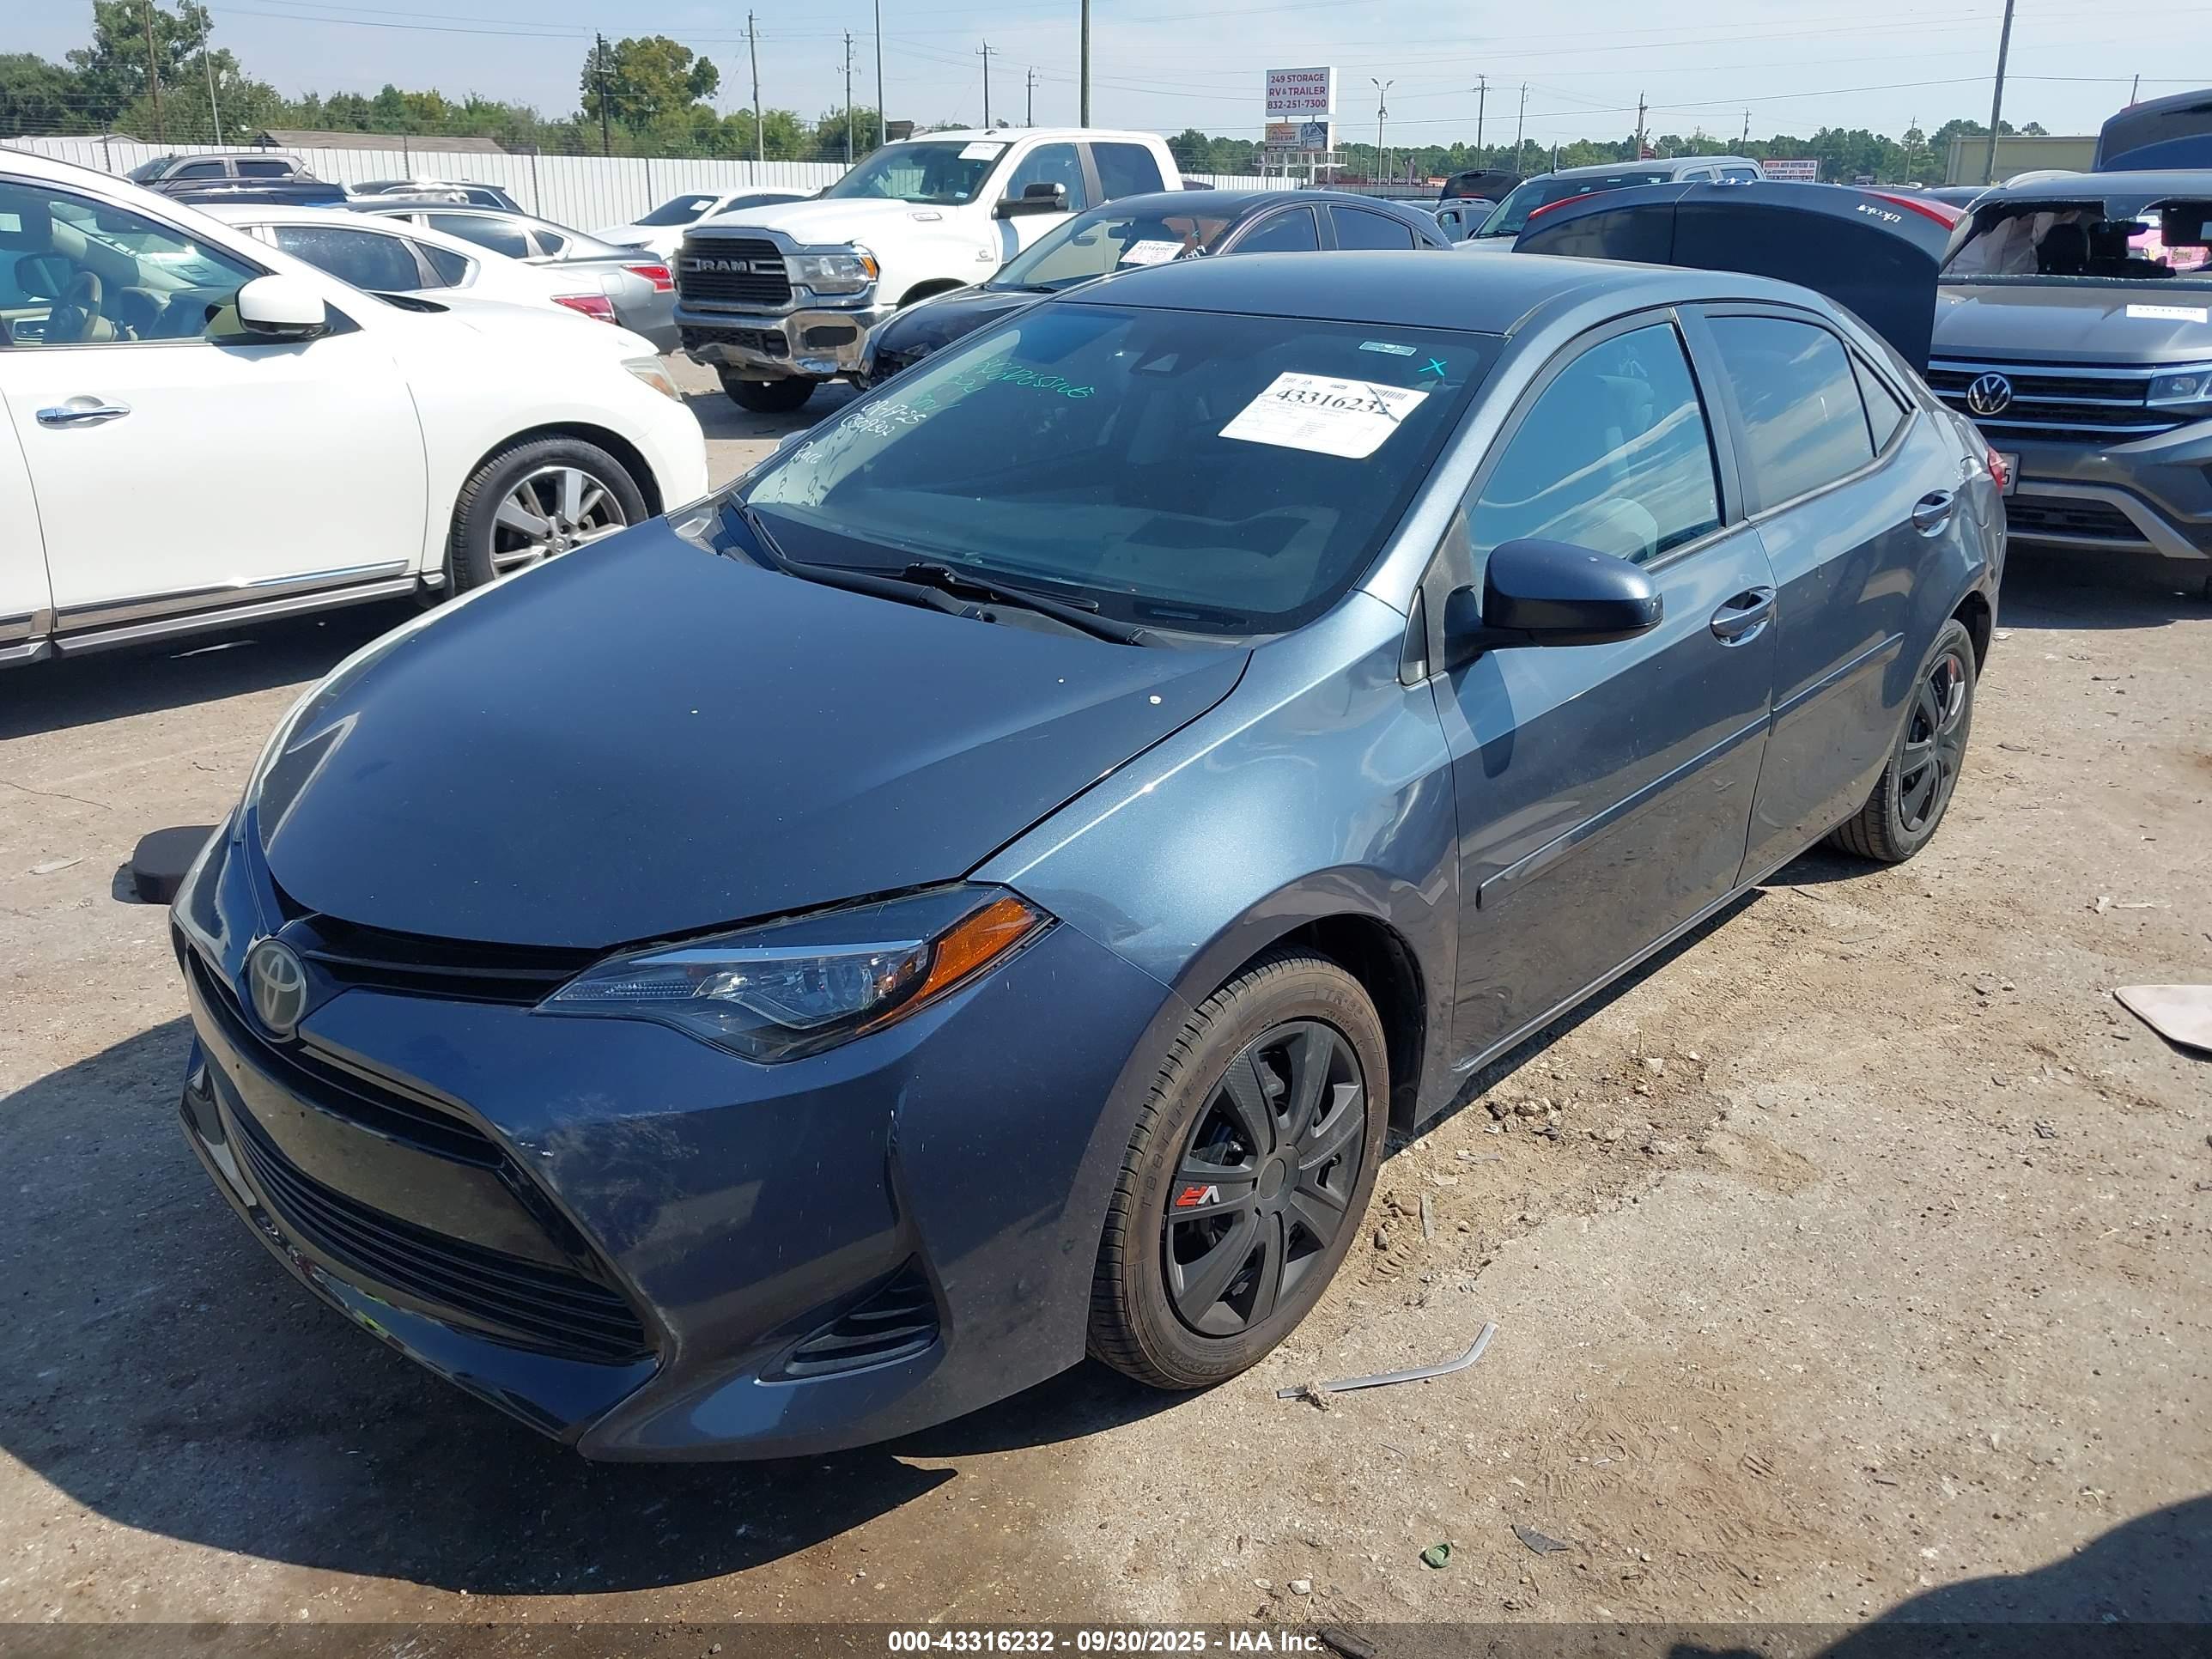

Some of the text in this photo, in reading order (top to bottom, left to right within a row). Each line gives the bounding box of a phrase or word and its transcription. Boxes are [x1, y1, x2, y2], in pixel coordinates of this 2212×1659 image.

[1286, 73, 1325, 82] STORAGE
[1269, 88, 1281, 97] RV
[1288, 86, 1326, 96] TRAILER
[1267, 99, 1327, 109] 832-251-7300
[700, 260, 747, 271] RAM
